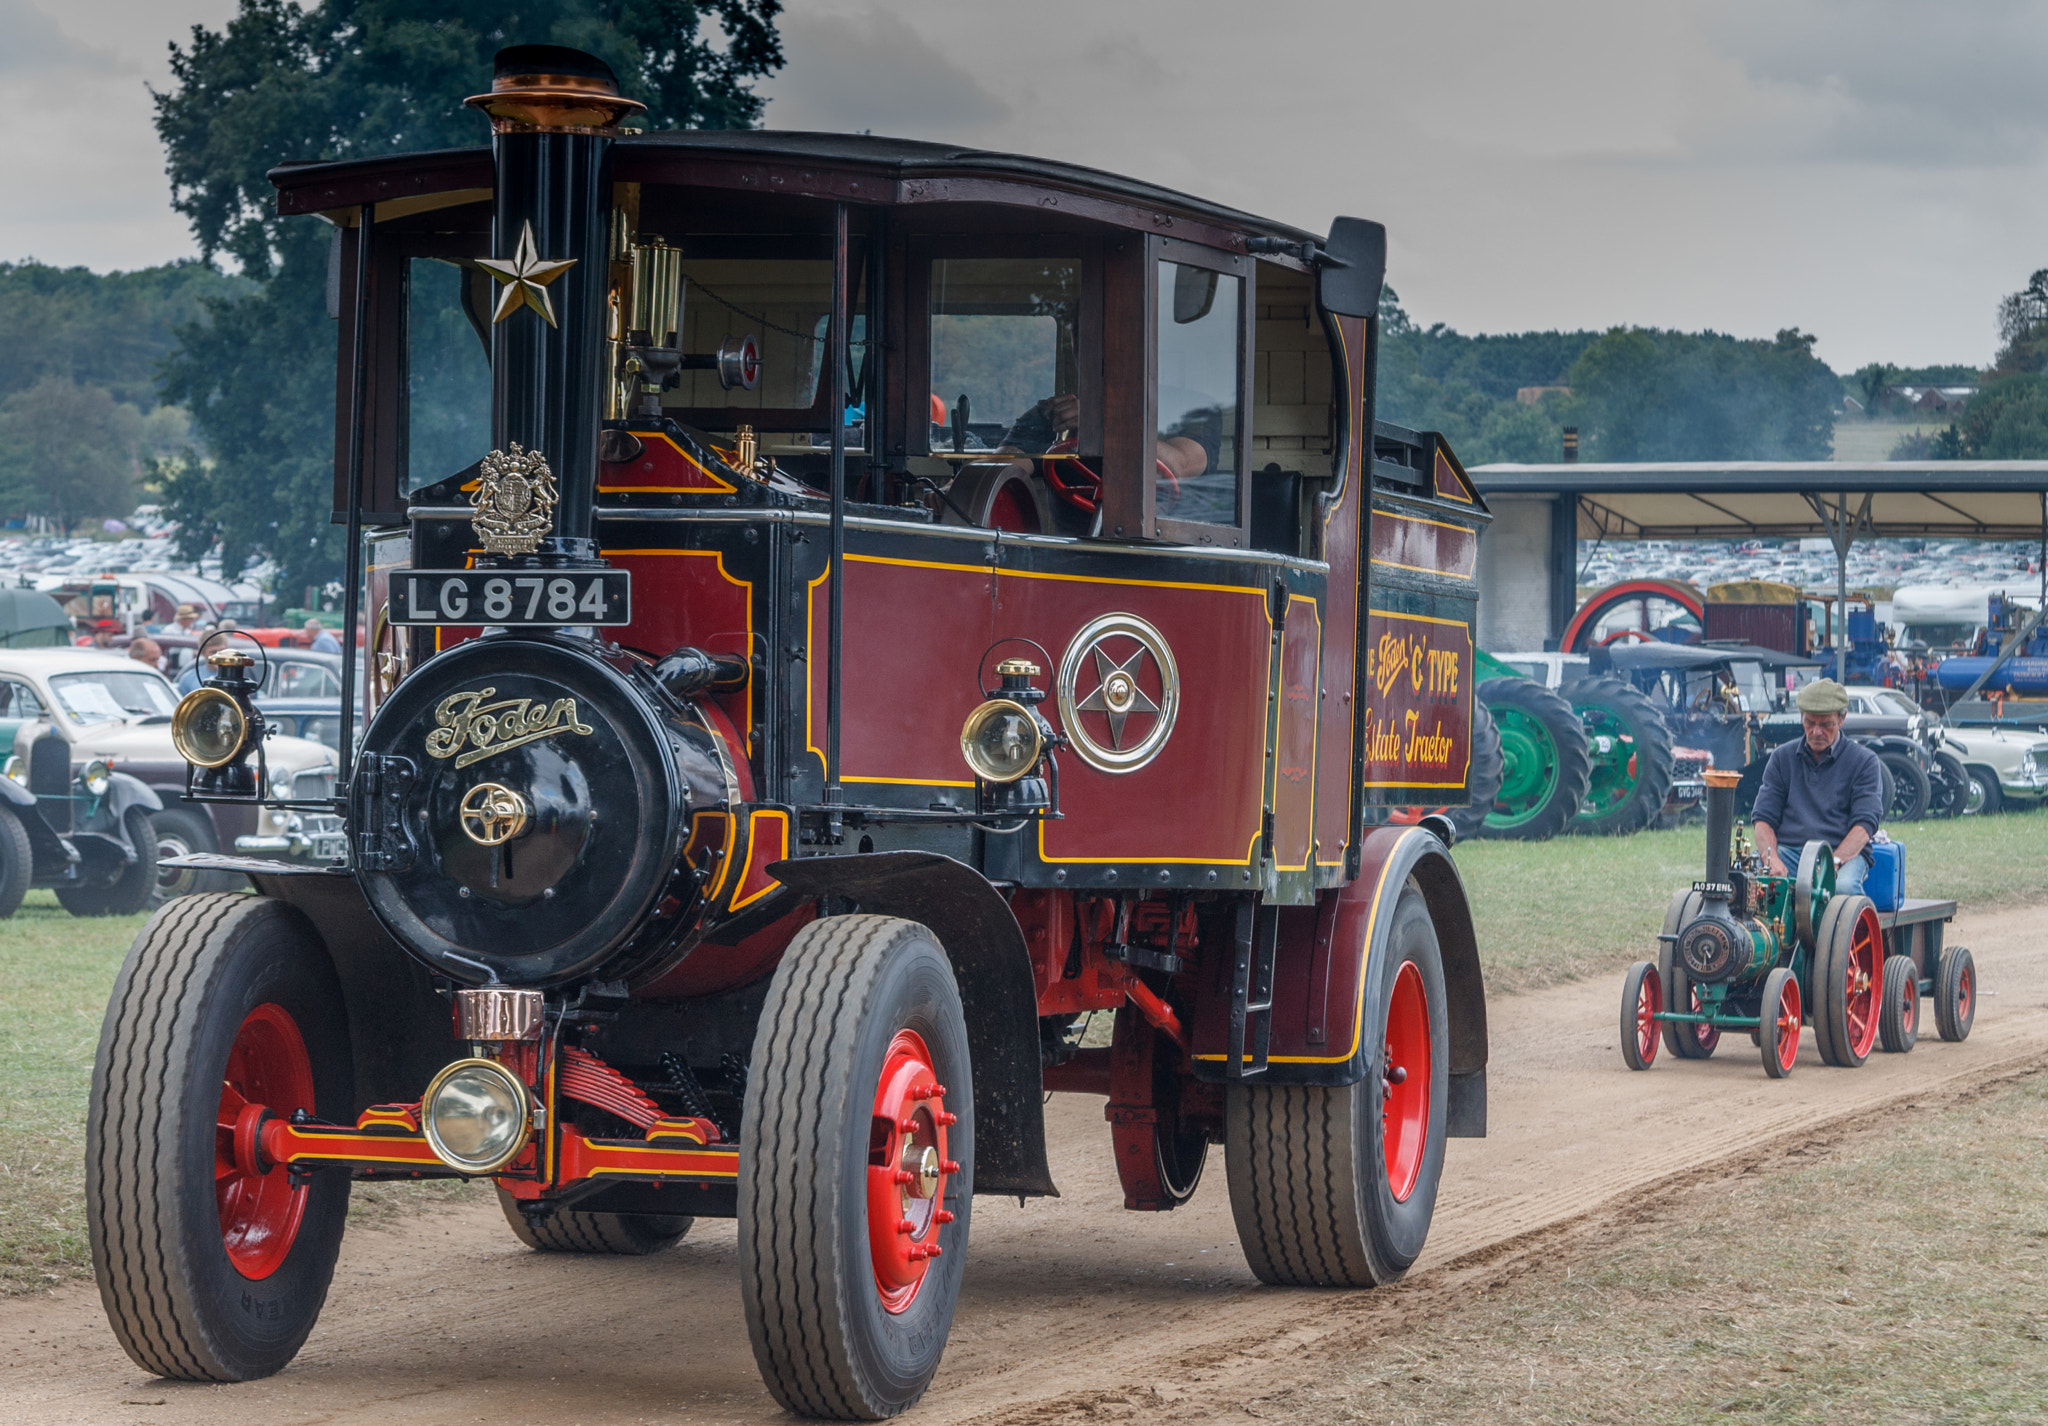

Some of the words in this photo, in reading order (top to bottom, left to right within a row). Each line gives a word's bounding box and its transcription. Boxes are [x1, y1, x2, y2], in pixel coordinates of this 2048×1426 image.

[408, 578, 469, 620] LG
[483, 578, 608, 620] 8784
[1377, 631, 1409, 699] Foden
[1427, 649, 1459, 695] TYPE
[425, 687, 594, 769] Foden
[1405, 708, 1453, 764] Tractor
